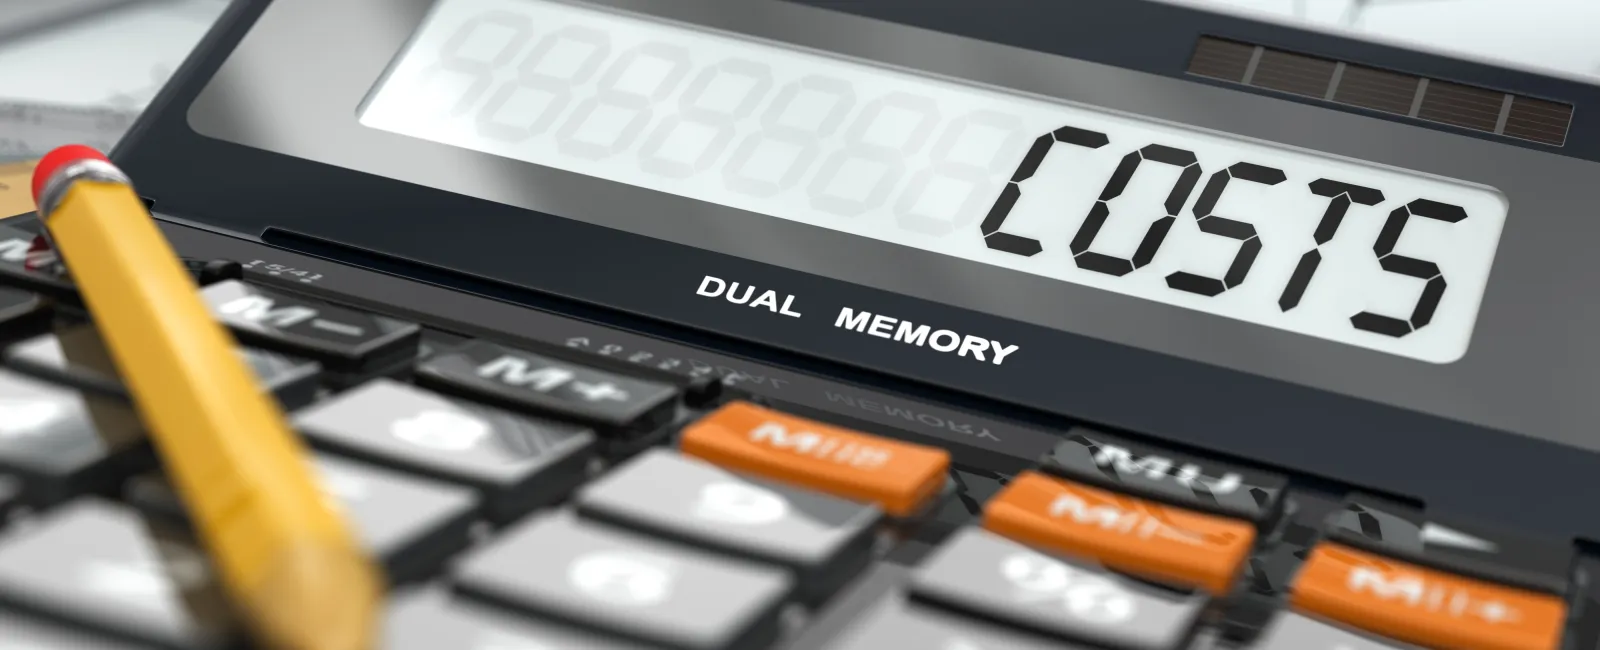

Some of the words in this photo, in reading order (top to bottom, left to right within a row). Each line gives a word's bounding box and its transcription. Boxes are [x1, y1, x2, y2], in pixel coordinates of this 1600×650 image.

[980, 125, 1469, 338] COSTS
[696, 275, 801, 317] DUAL
[834, 307, 1019, 365] MEMORY
